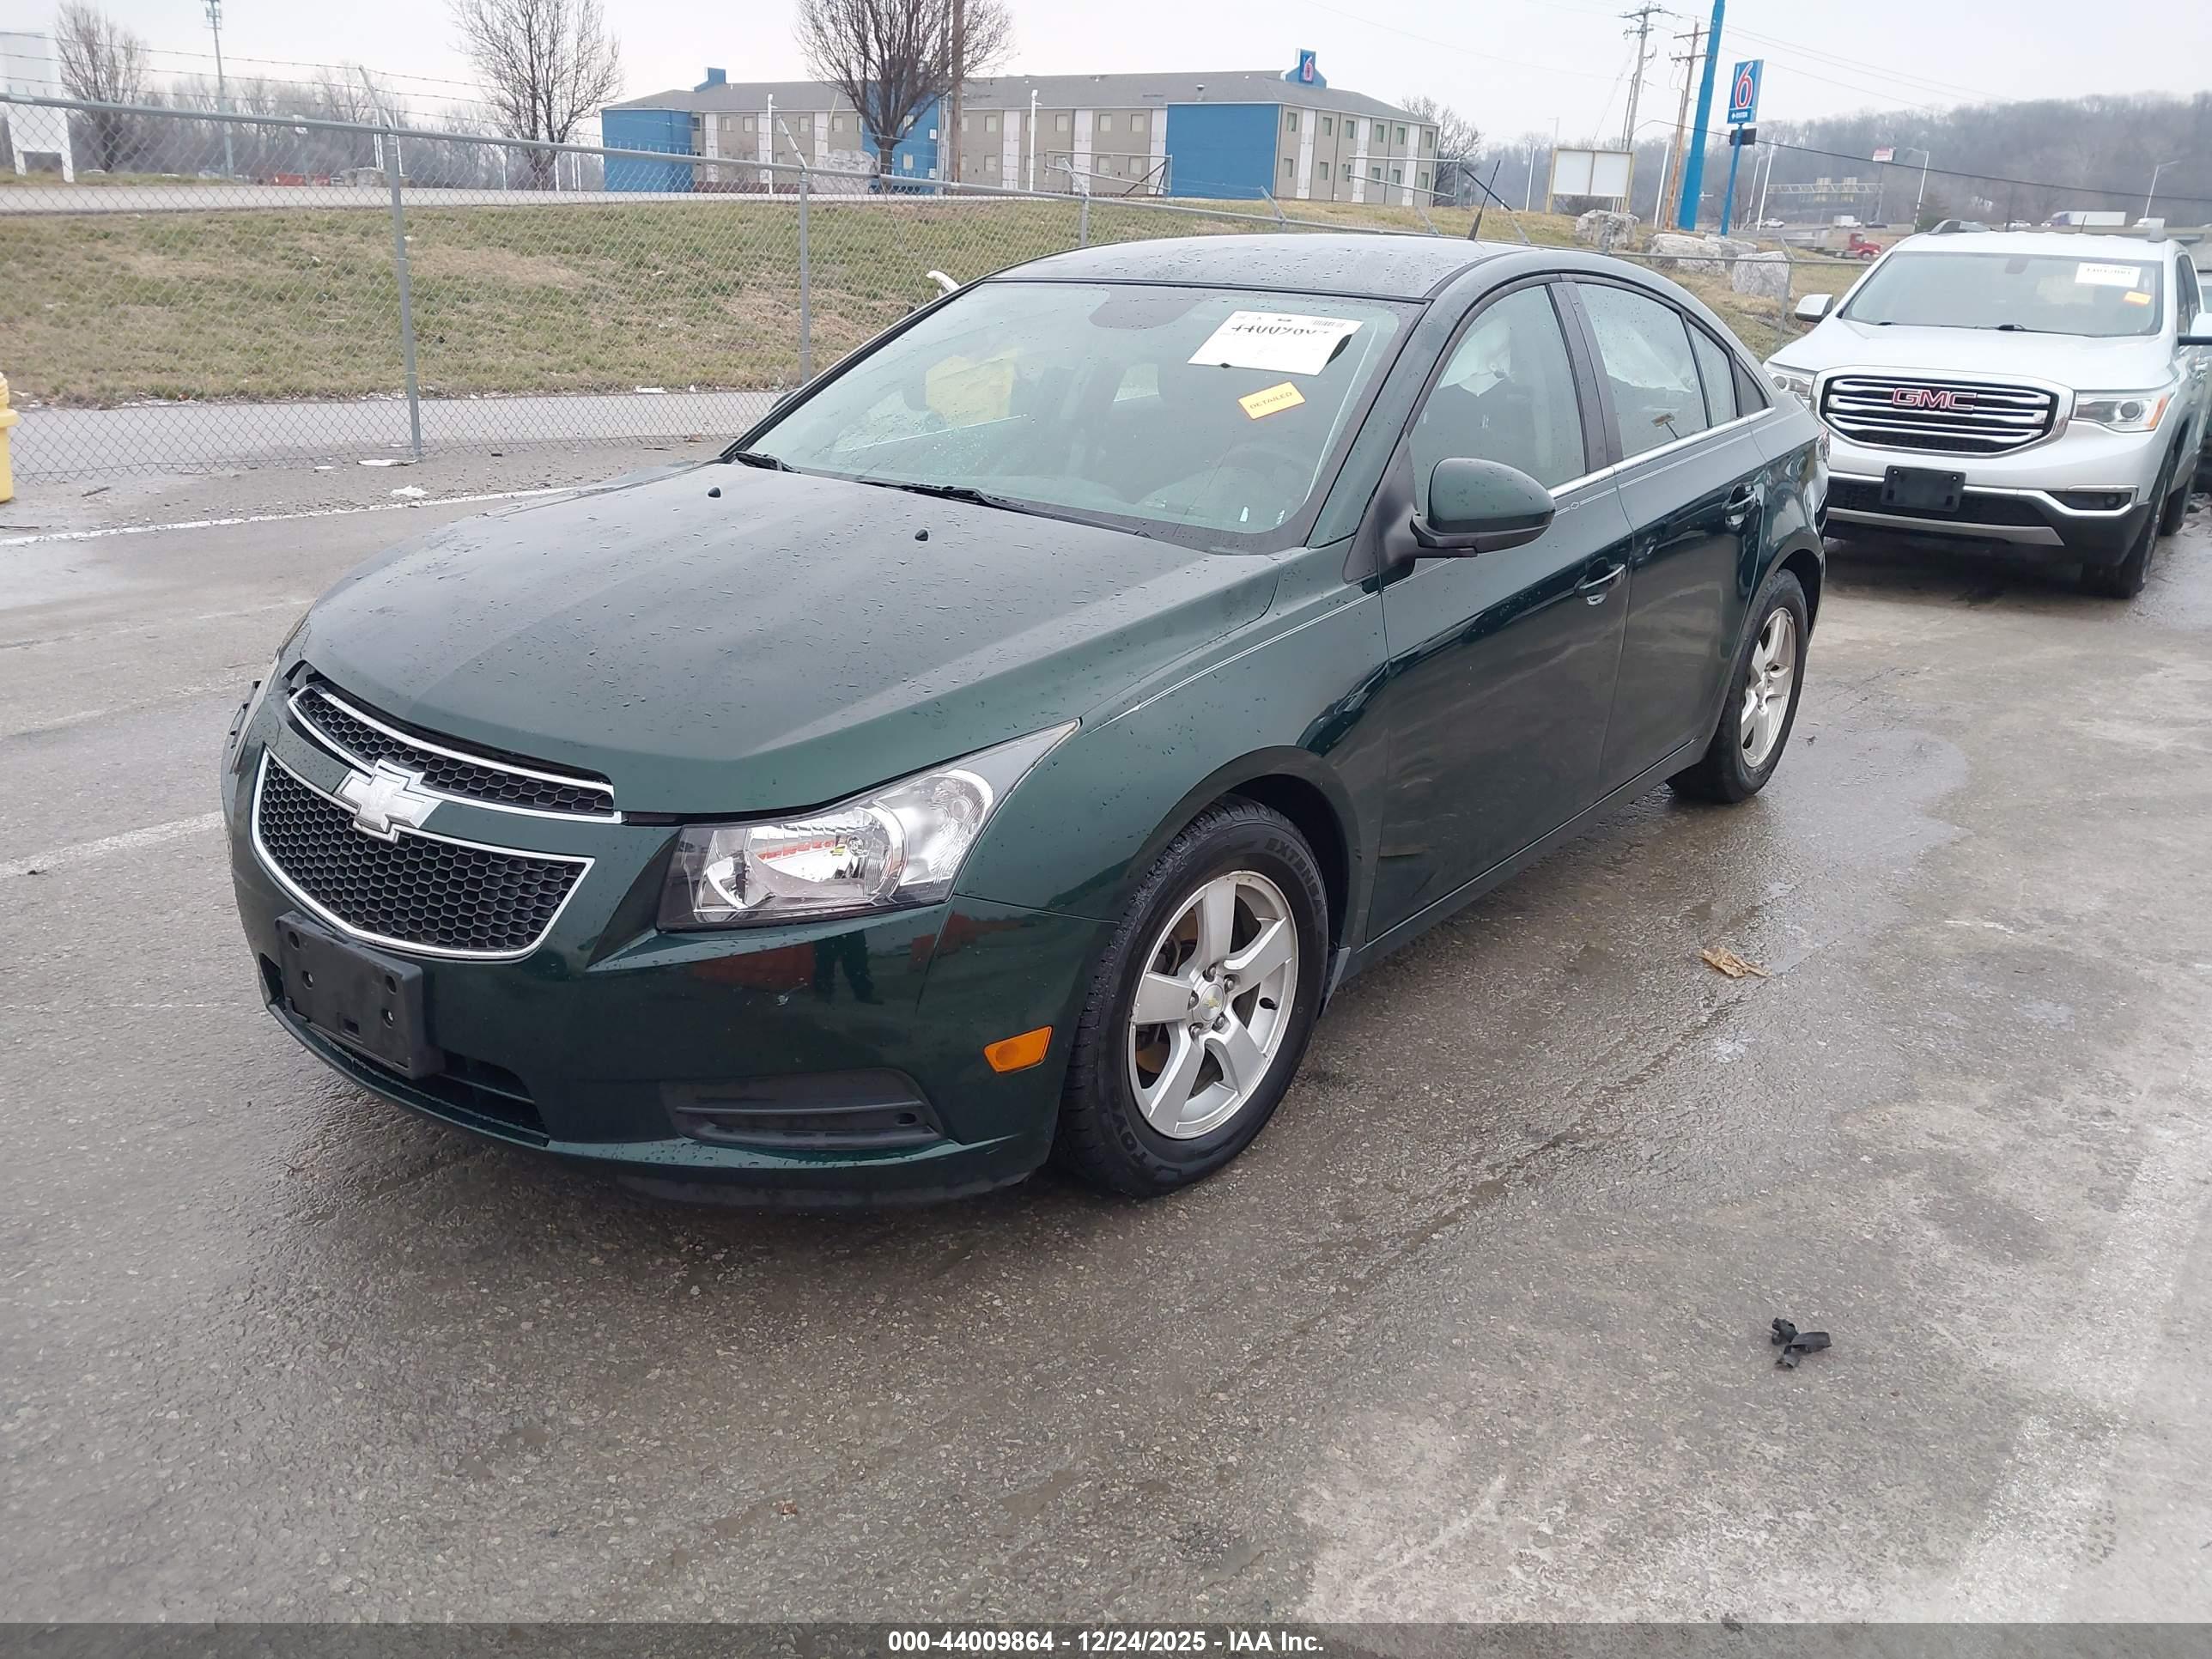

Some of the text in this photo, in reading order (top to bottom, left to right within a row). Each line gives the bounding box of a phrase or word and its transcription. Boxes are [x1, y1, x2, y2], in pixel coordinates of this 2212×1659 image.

[1304, 56, 1314, 82] 6
[1735, 61, 1753, 109] 6
[1249, 392, 1292, 410] DETAILED
[1893, 387, 1977, 410] GMC
